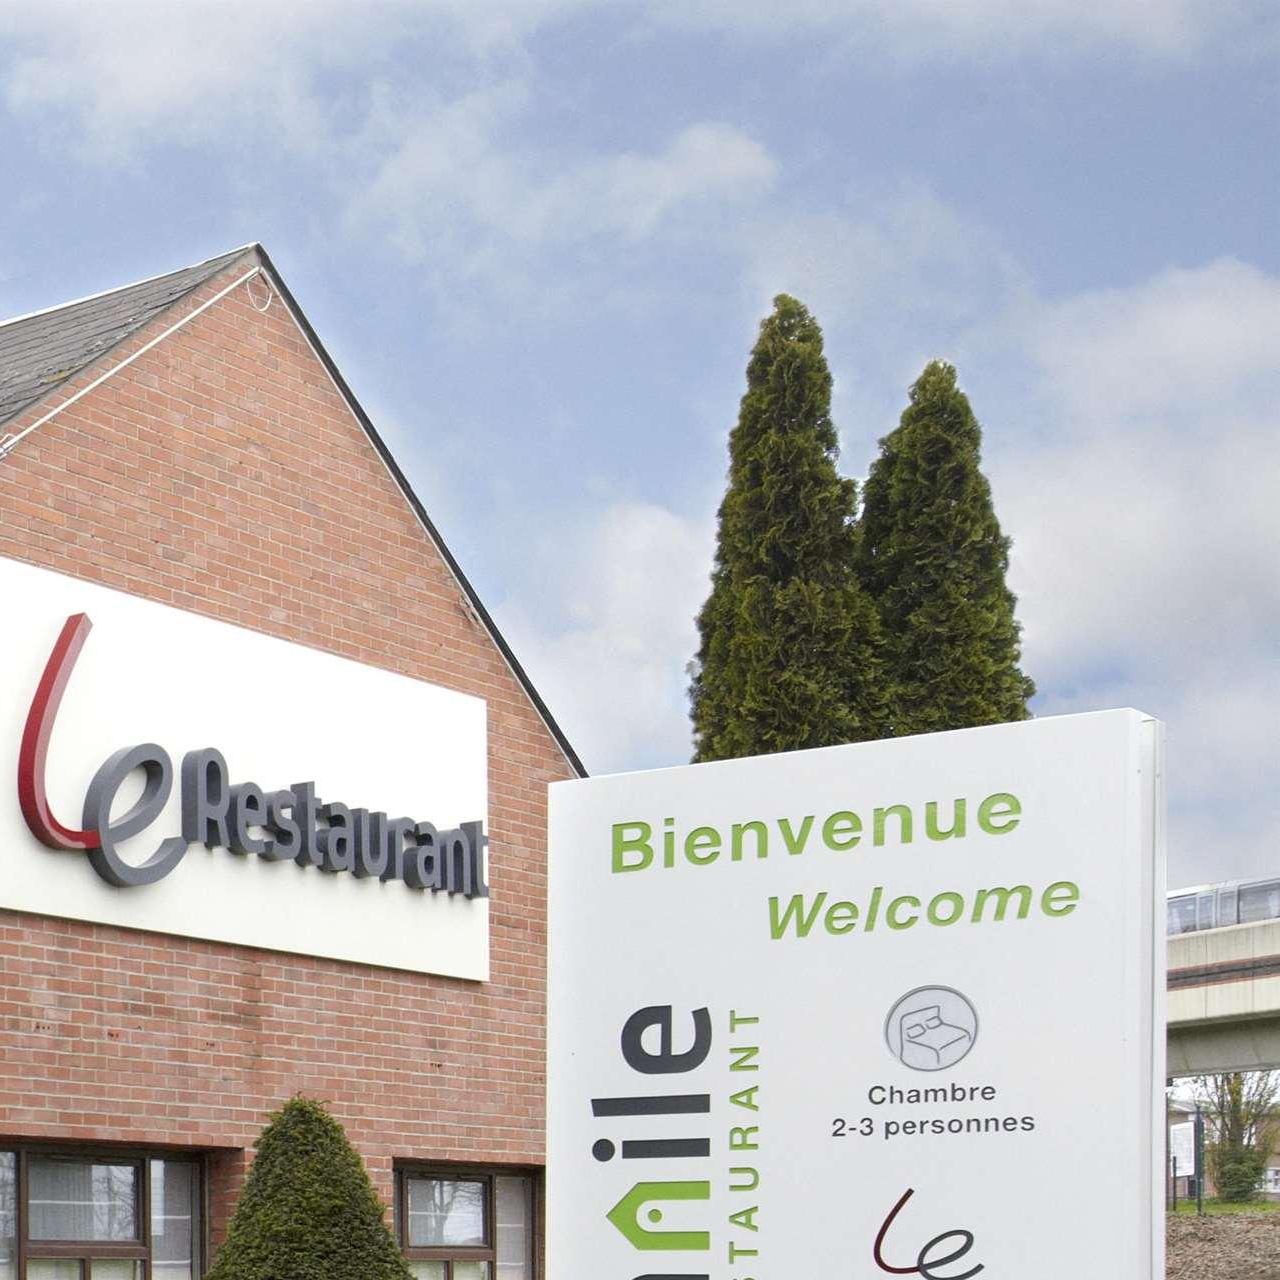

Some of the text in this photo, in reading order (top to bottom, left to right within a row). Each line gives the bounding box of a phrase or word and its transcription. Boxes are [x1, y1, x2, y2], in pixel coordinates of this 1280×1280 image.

[18, 612, 489, 899] Le Restaurant
[611, 791, 1023, 874] Bienvenue
[768, 880, 1081, 941] Welcome
[868, 1081, 998, 1107] Chambre
[832, 1115, 1036, 1142] 2-3 personnes
